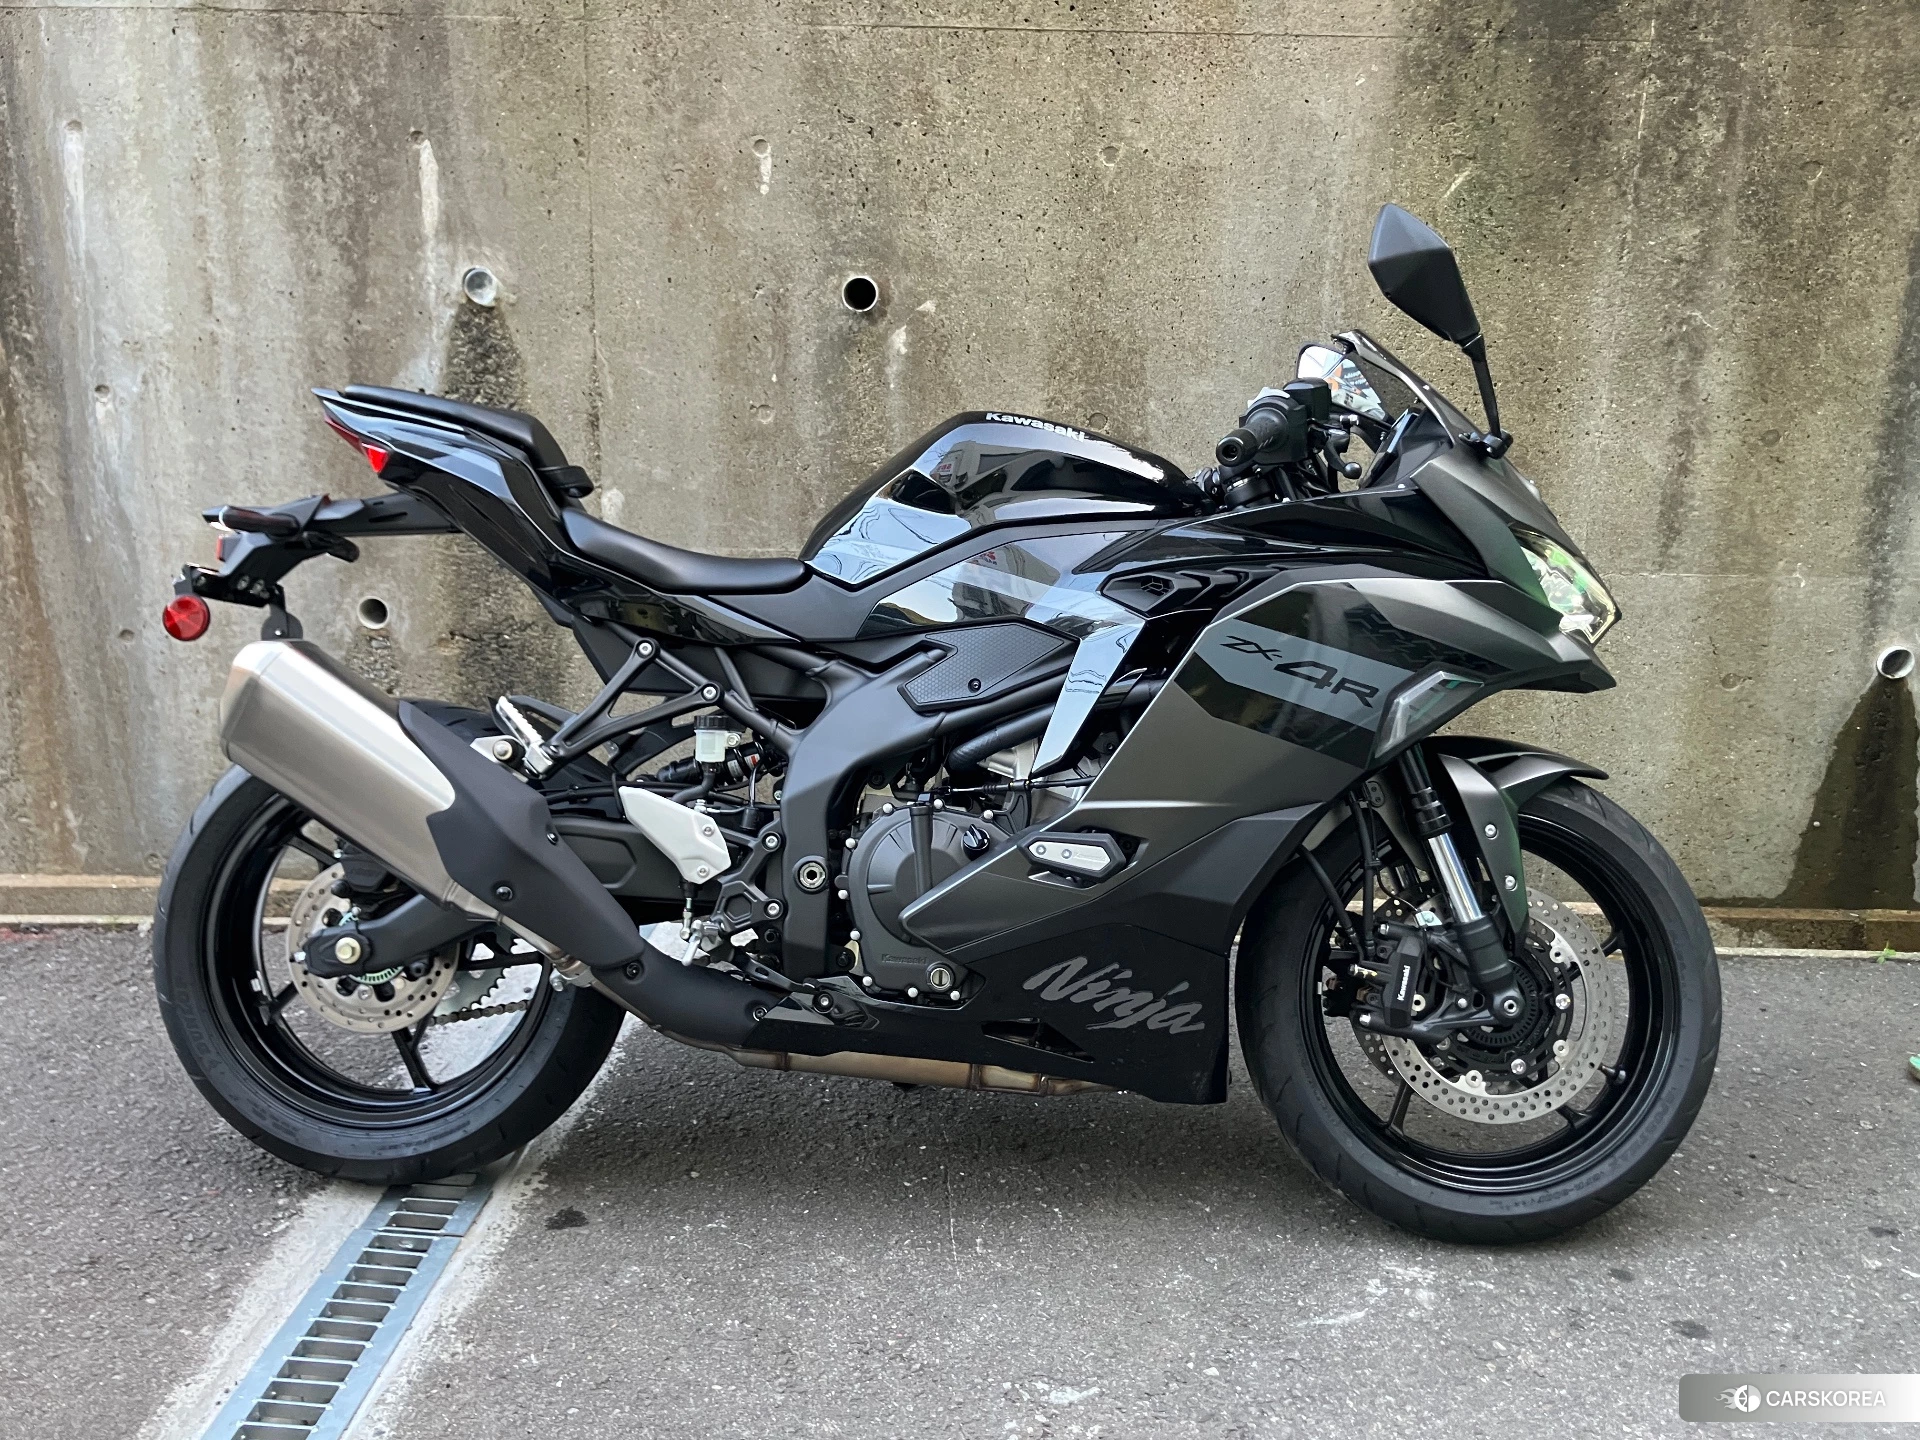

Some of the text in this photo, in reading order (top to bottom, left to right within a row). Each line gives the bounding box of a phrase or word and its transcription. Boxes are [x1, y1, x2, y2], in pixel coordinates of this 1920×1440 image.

[985, 412, 1084, 443] Kawasaki
[1219, 635, 1380, 709] ZX-4R
[1022, 956, 1205, 1034] Ninja
